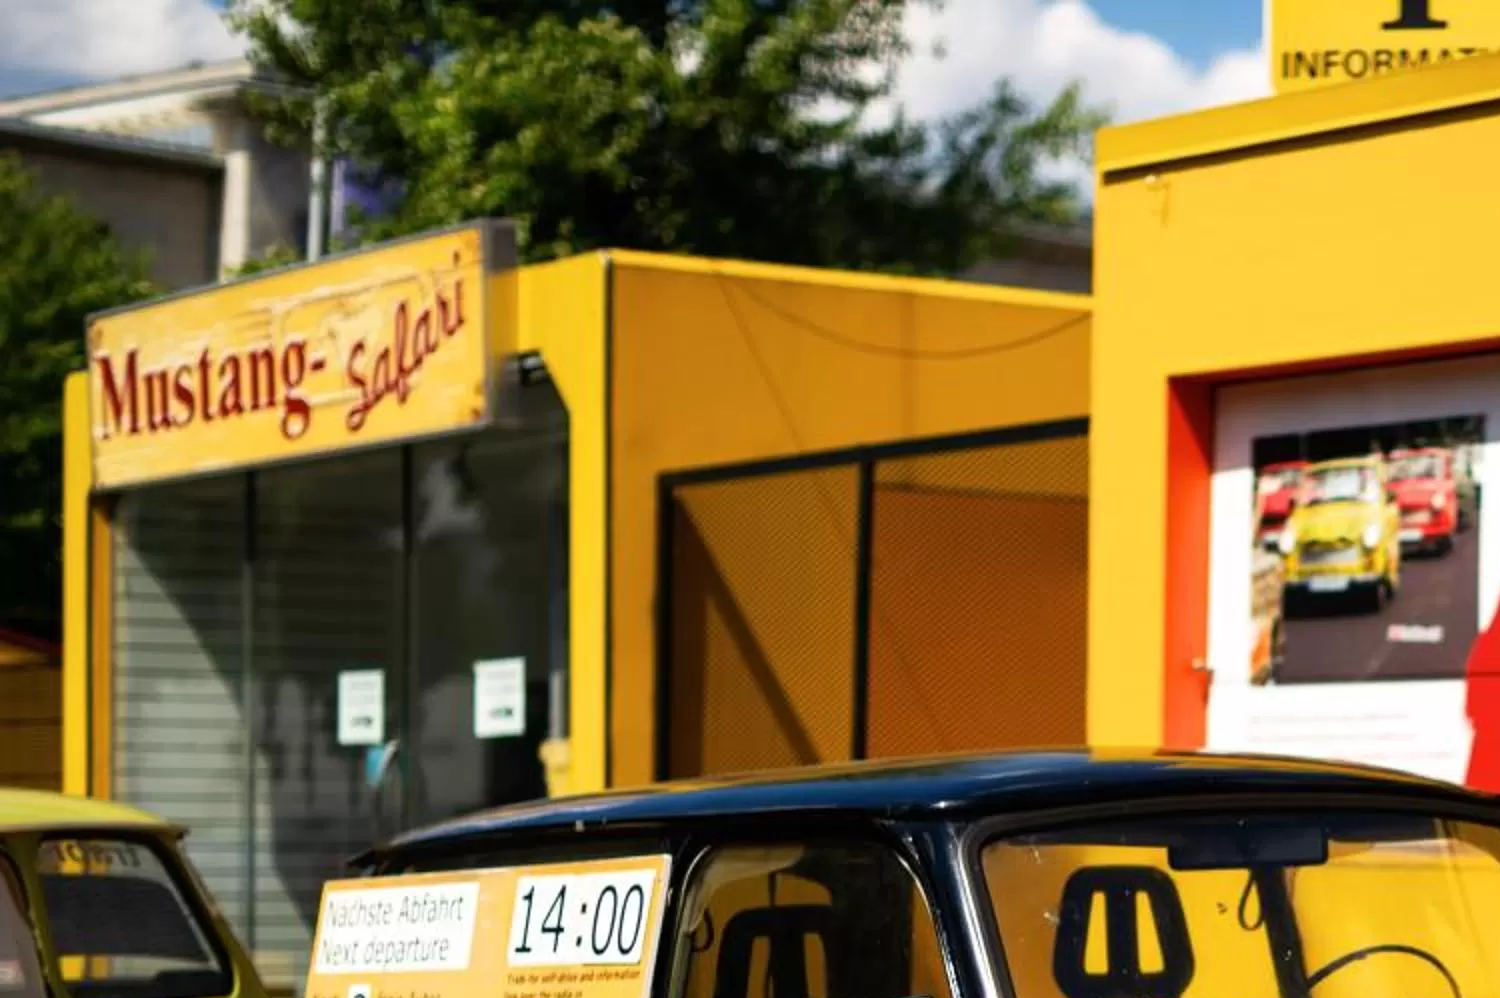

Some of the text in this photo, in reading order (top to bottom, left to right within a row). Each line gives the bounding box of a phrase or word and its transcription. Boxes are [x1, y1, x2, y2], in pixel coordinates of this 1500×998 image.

[97, 251, 464, 440] Mustang- Safari
[398, 891, 464, 924] Abfahrt
[514, 884, 646, 956] 14:00
[322, 936, 449, 970] Next departure
